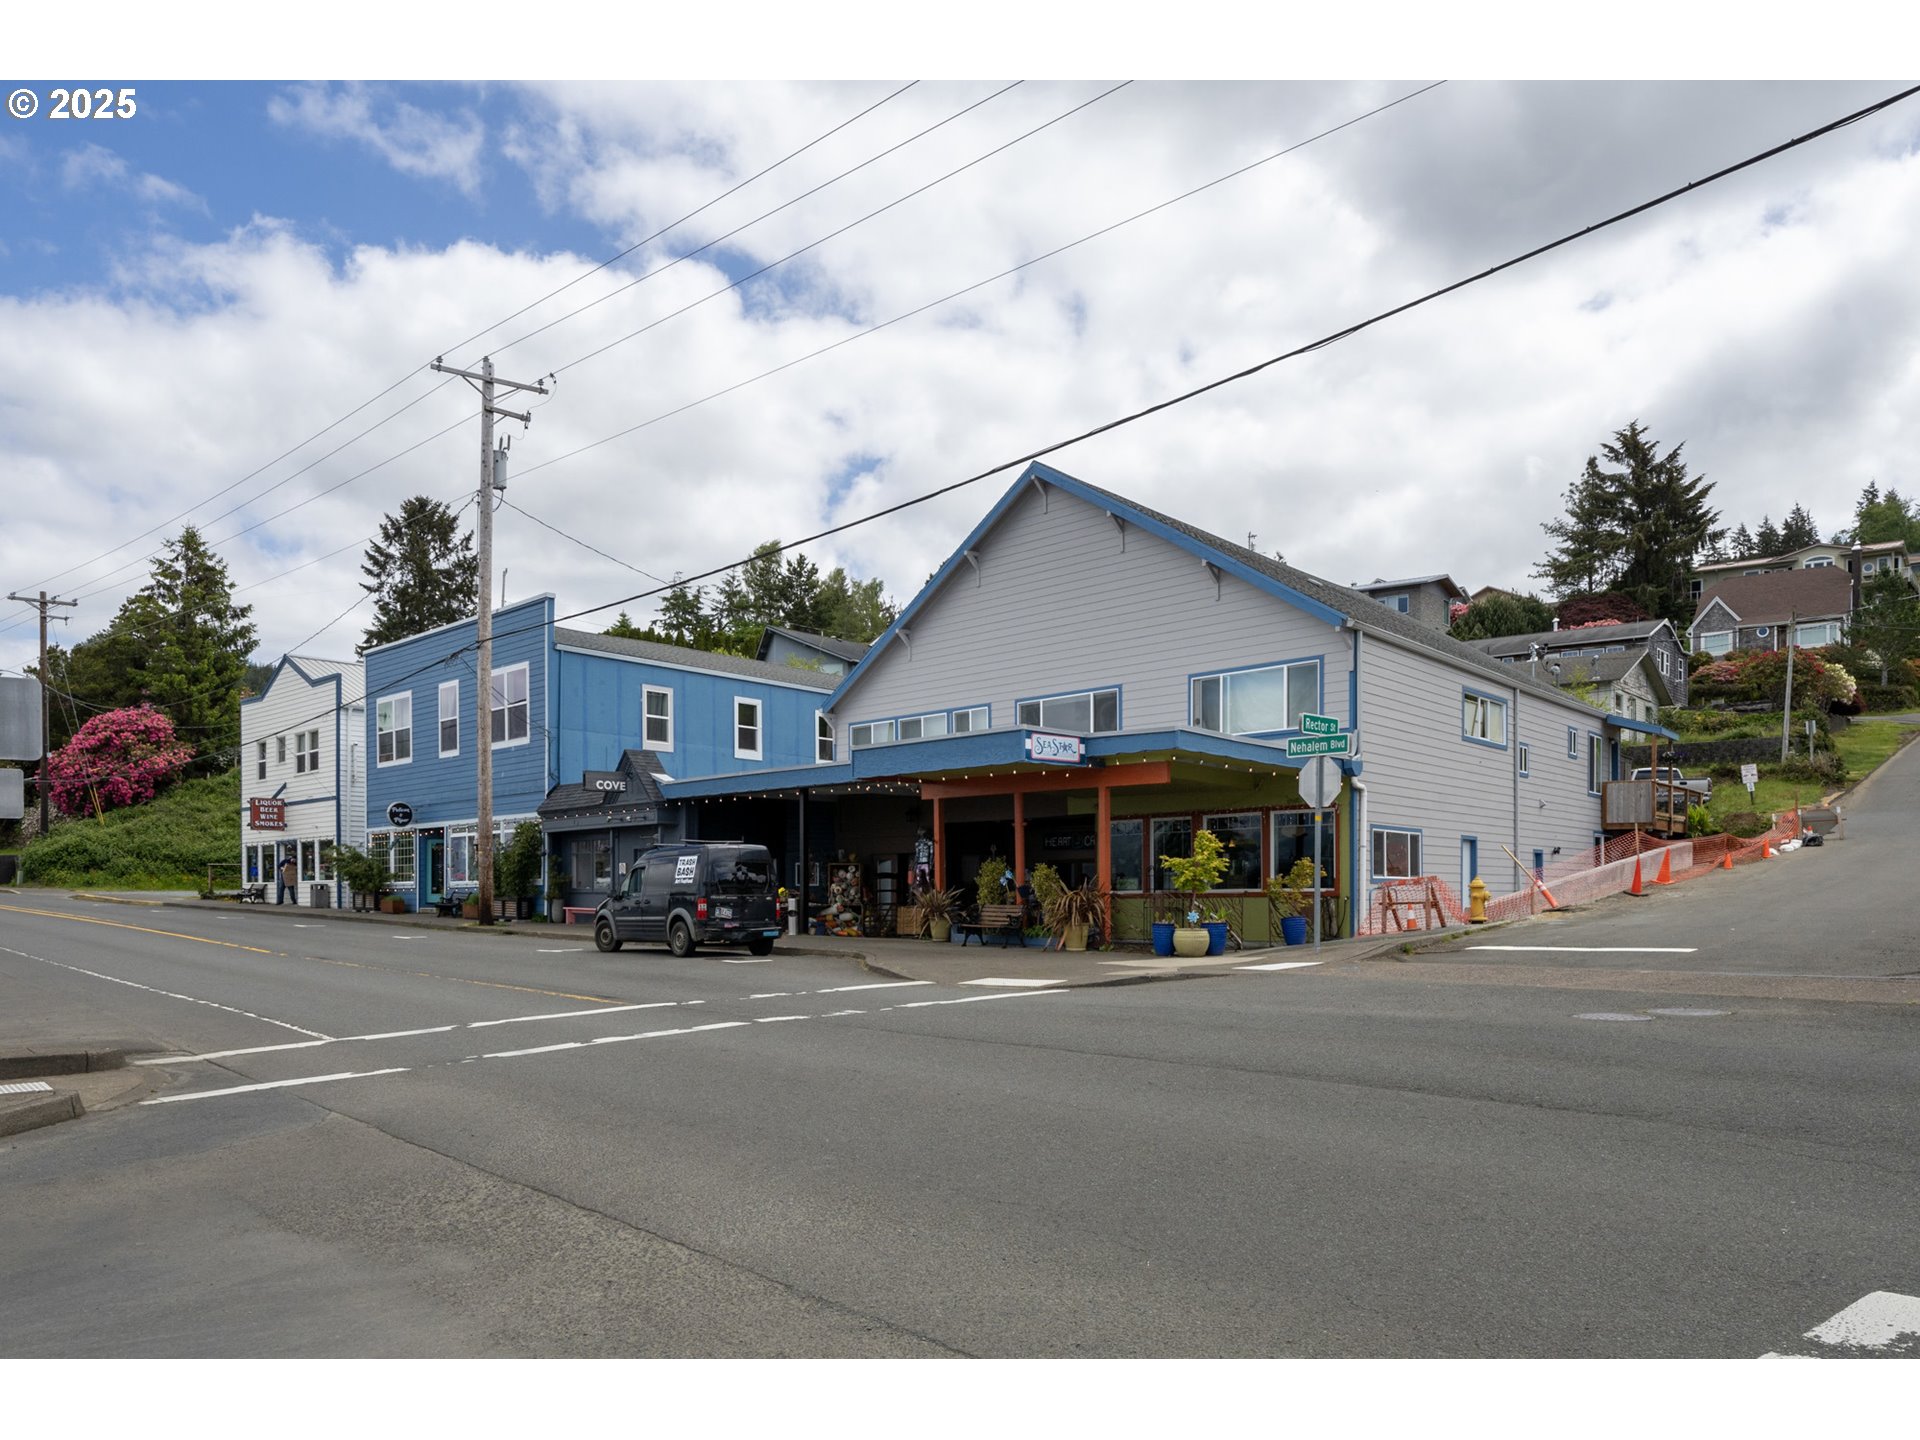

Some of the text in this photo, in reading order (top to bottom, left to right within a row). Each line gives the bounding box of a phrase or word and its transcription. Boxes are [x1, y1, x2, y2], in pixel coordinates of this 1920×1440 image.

[1305, 717, 1336, 732] Rector St
[1290, 739, 1346, 754] Nehalem Blvd
[596, 780, 626, 790] COVE
[676, 866, 694, 877] BASH
